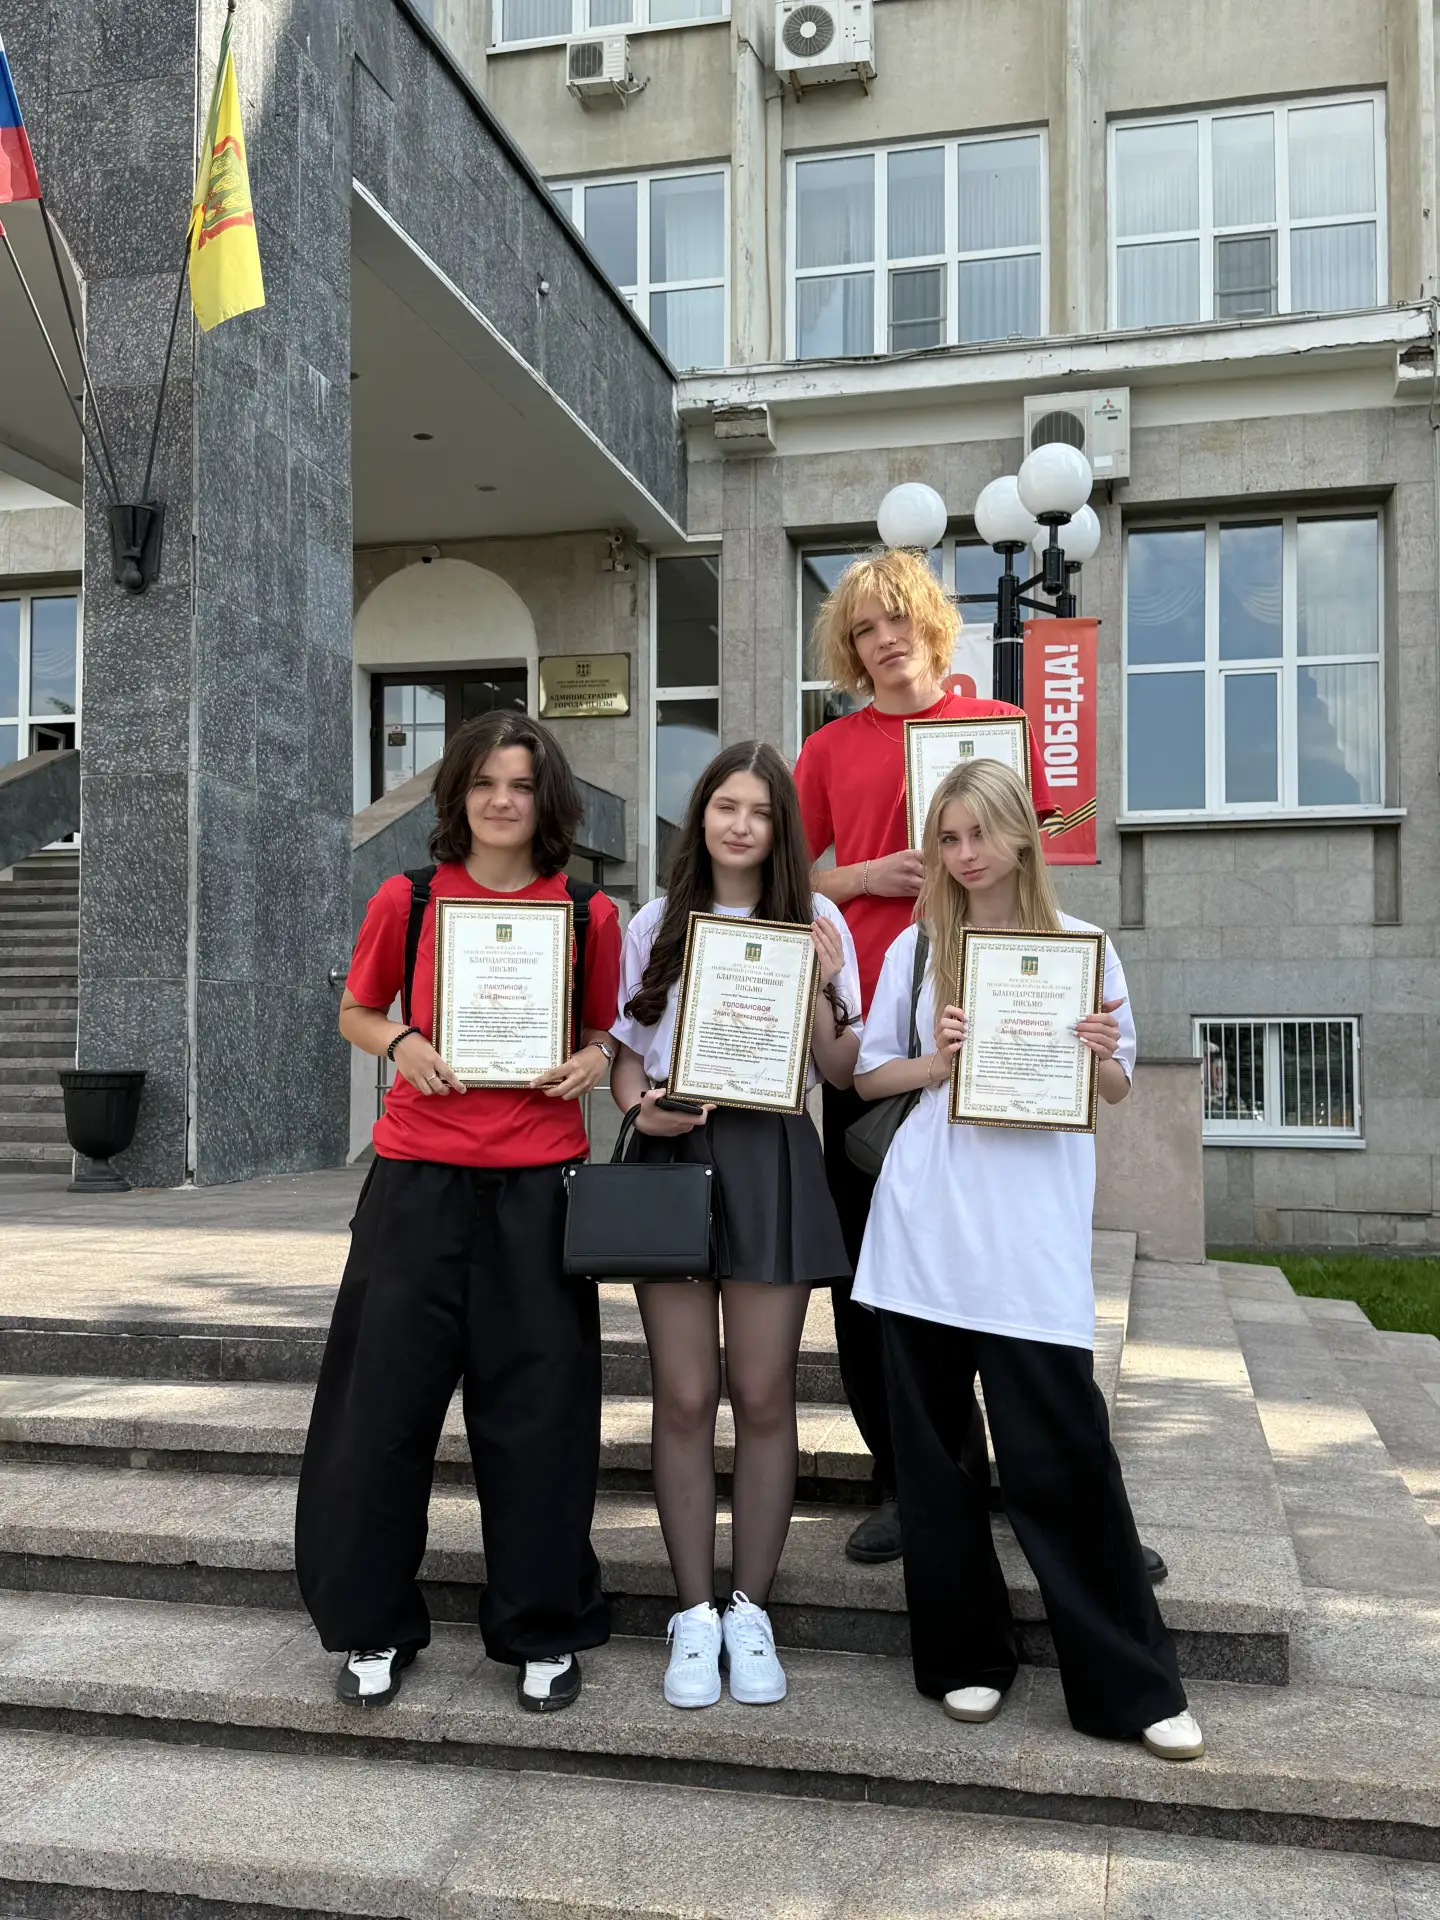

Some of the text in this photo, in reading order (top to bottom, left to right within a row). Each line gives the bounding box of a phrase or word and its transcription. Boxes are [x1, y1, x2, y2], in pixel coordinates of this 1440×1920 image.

[550, 692, 618, 701] АДМИНИСТРАЦИЯ
[554, 701, 584, 709] ГОРОДА
[1043, 644, 1084, 787] ПОБЕДА!
[469, 956, 538, 965] БЛАГОДАРСТВЕННОЕ
[489, 965, 518, 973] ПИСЬМО
[716, 972, 784, 987] БЛАГОДАРСТВЕННОЕ
[483, 983, 523, 991] ПАКУЛИНОЙ
[735, 983, 763, 993] ПИСЬМО
[992, 989, 1065, 1000] БЛАГОДАРСТВЕННОЕ
[1012, 999, 1043, 1008] ПИСЬМО
[1004, 1018, 1050, 1027] КРАПИВИНОЙ
